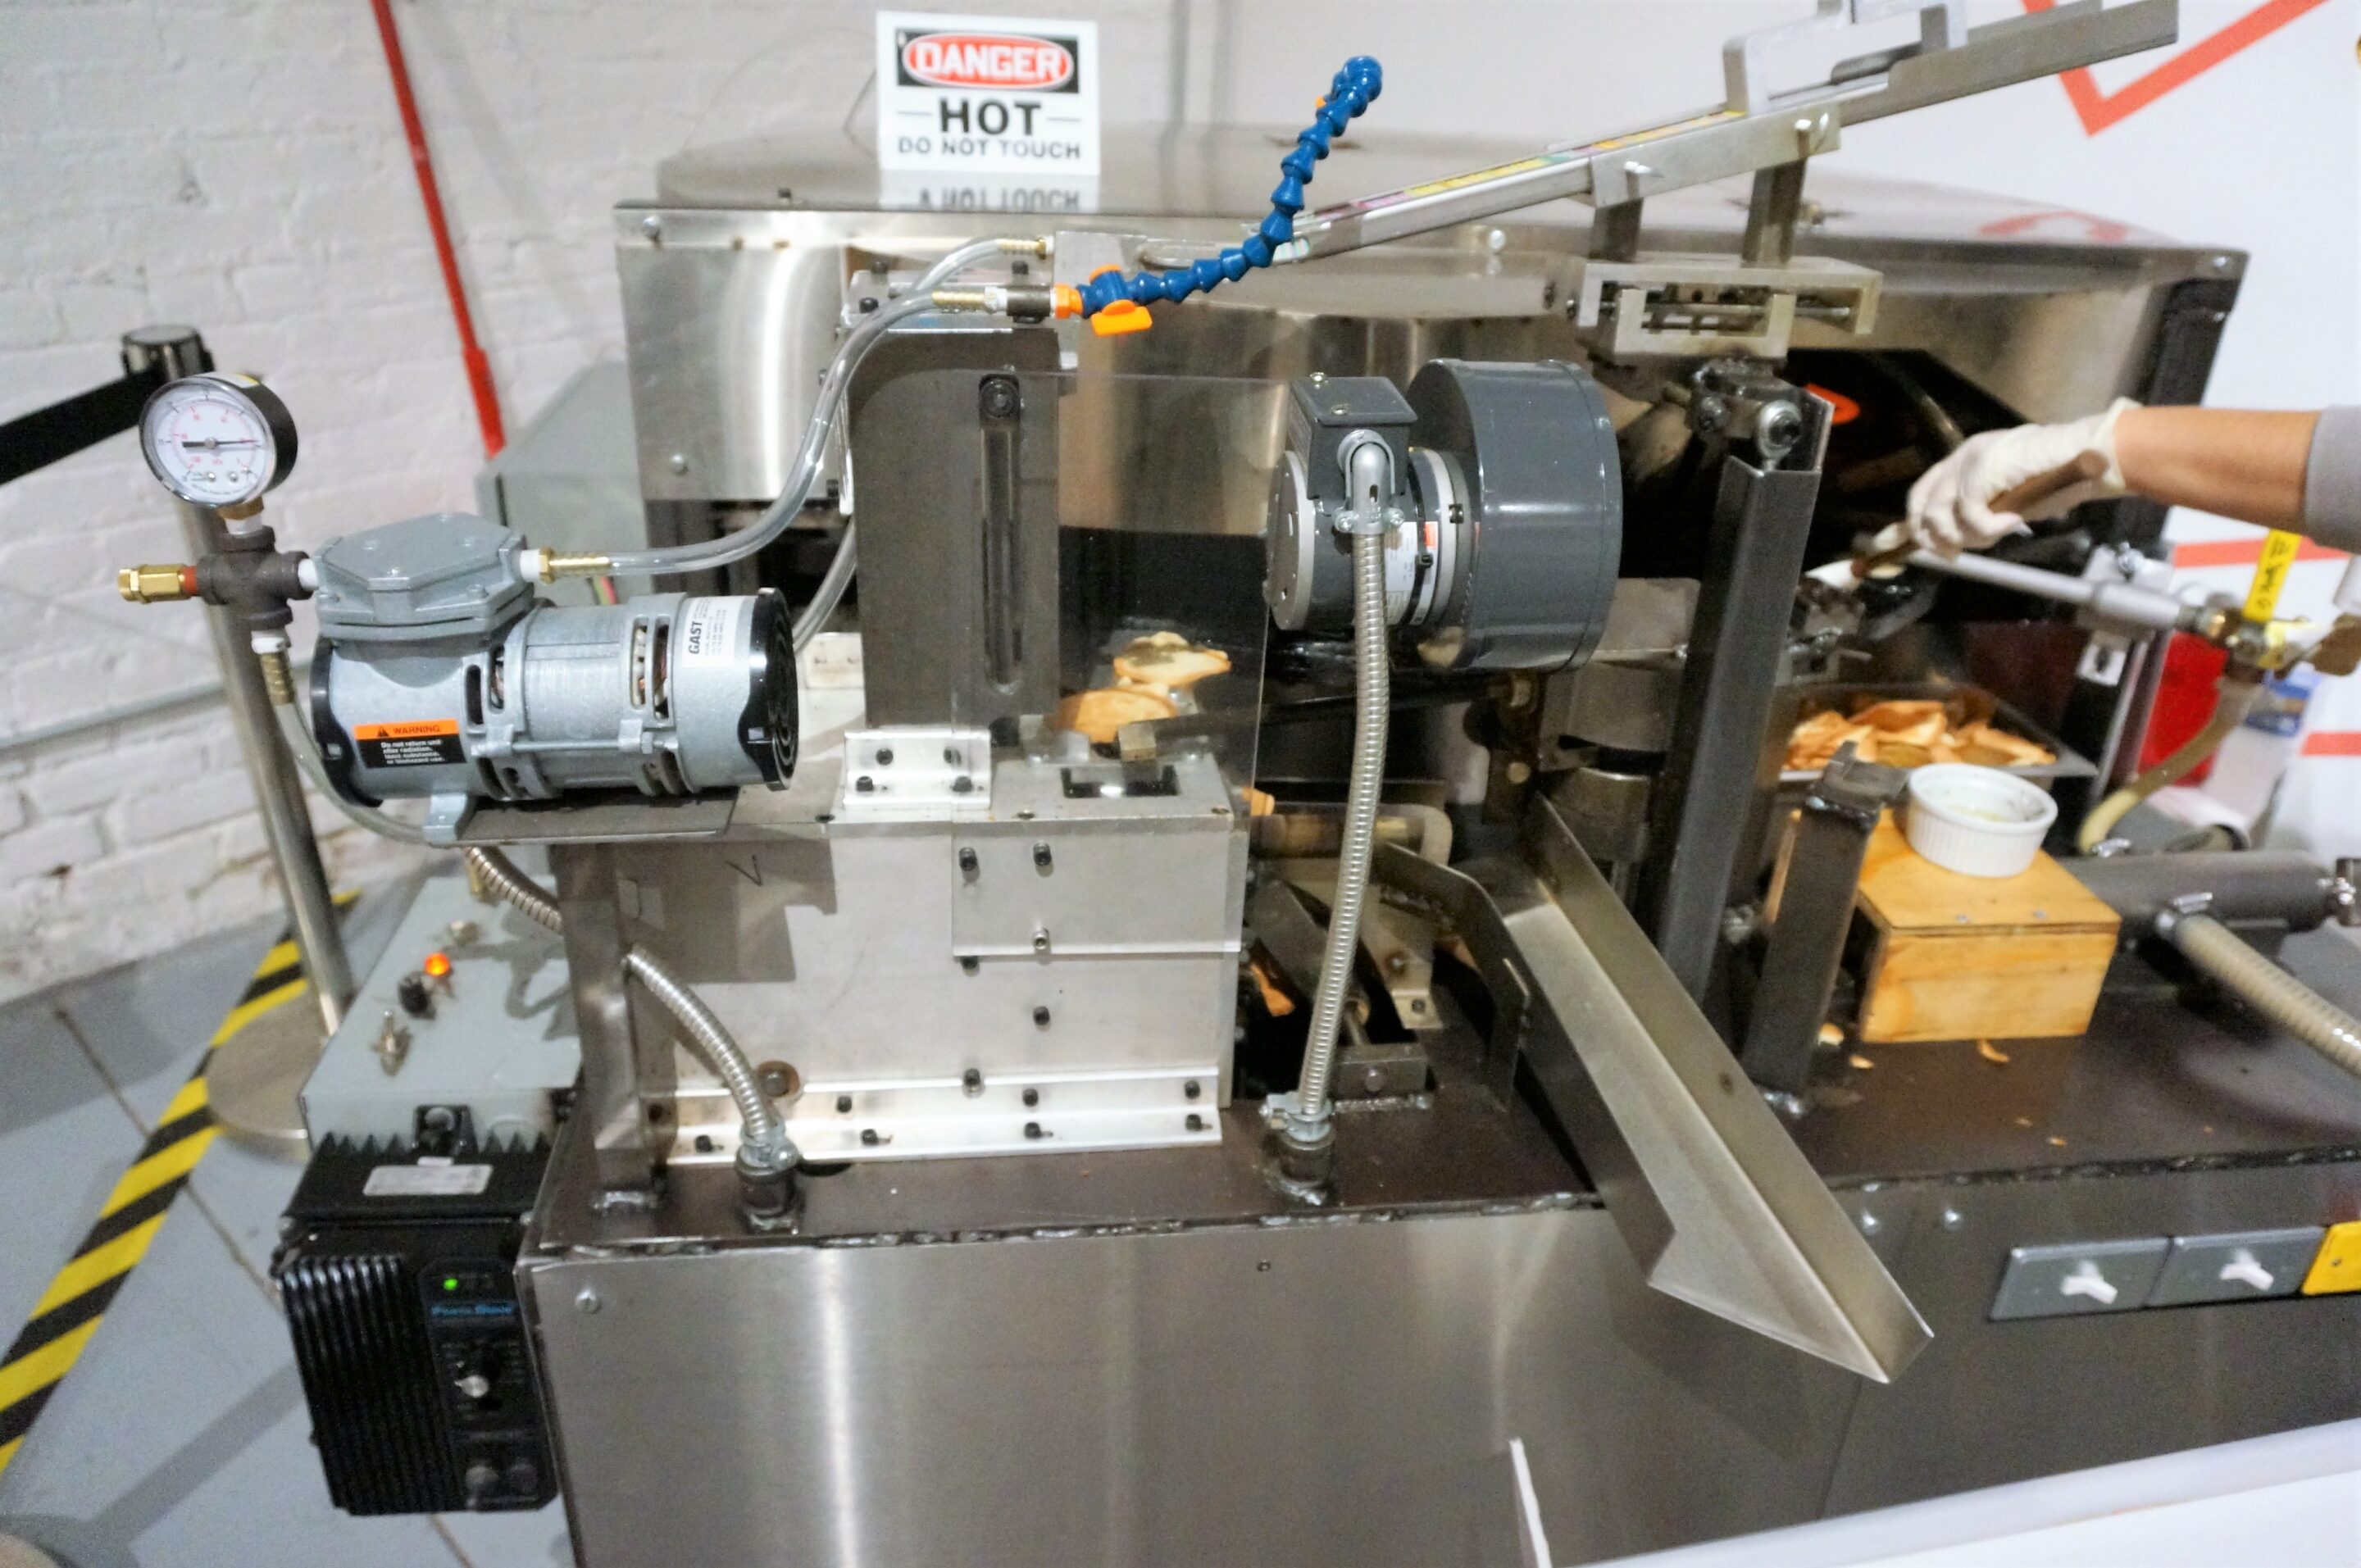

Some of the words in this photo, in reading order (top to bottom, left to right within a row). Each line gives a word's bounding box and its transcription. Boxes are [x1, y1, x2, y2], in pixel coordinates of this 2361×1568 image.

[914, 41, 1062, 80] DANGER
[939, 98, 1041, 135] HOT
[898, 137, 930, 154] DO
[942, 139, 989, 156] NOT
[998, 140, 1080, 159] TOUCH
[689, 620, 703, 654] GAST
[393, 725, 440, 735] WARNING
